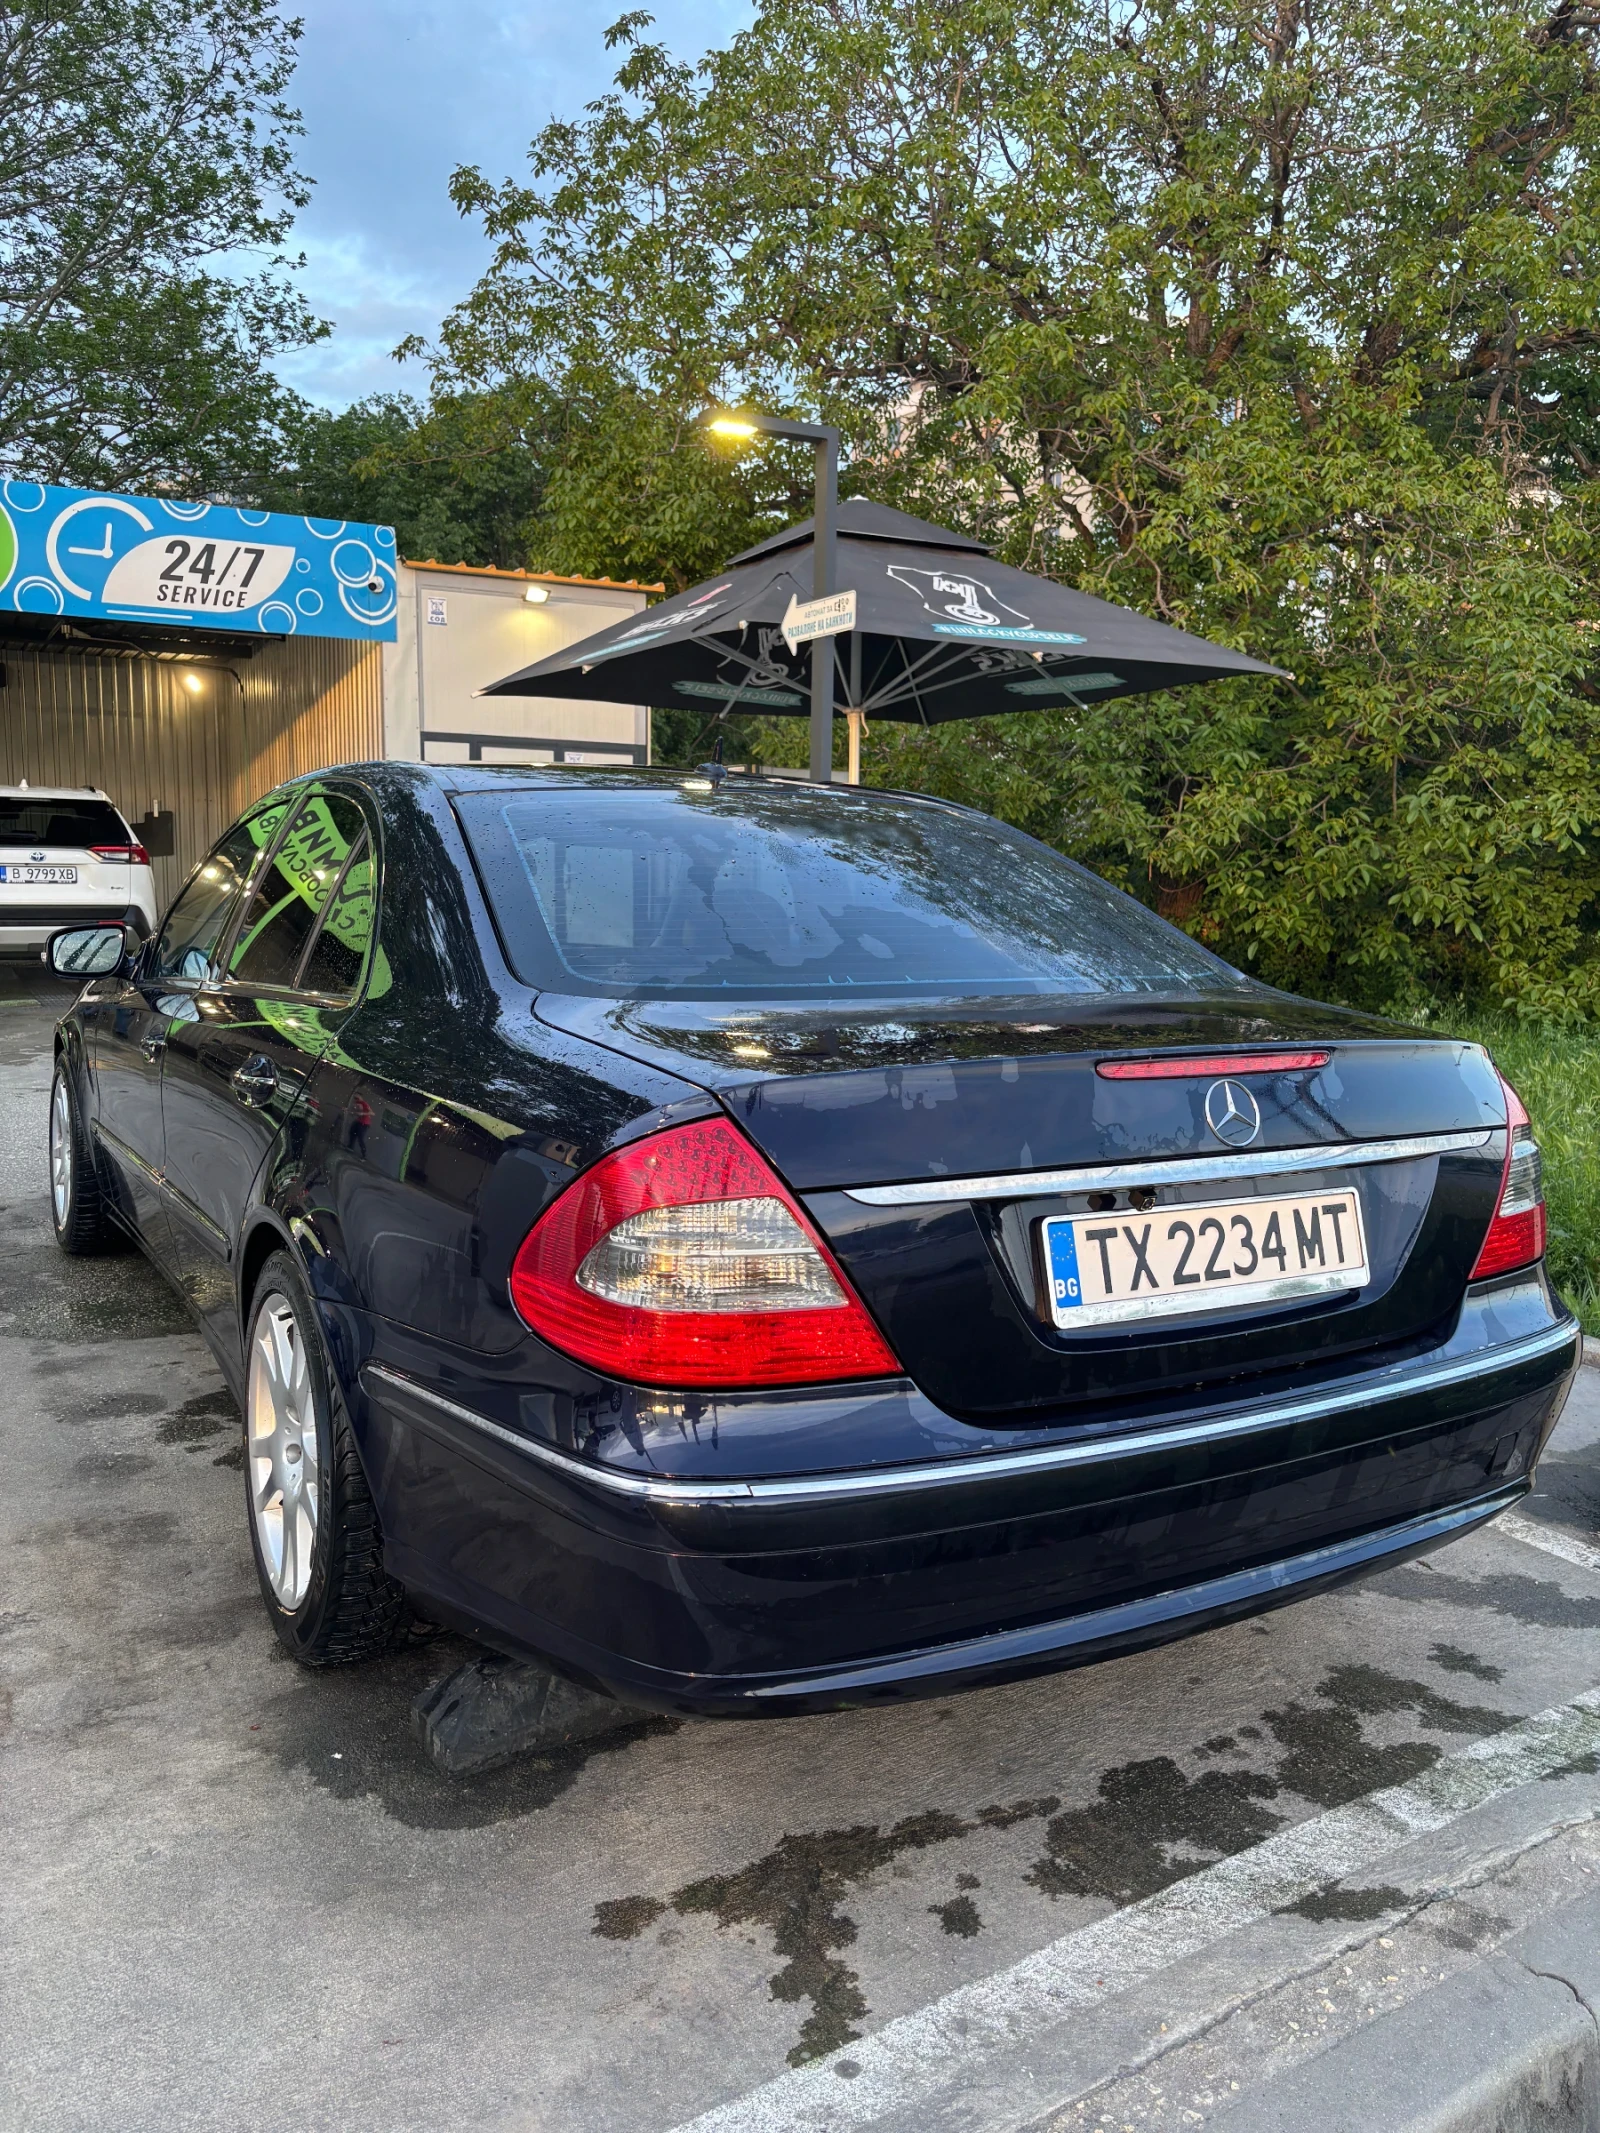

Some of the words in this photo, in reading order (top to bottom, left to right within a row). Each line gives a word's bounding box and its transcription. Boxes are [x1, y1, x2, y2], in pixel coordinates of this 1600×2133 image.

[160, 540, 265, 587] 24/7
[157, 584, 248, 608] SERVICE
[12, 868, 21, 879] B
[27, 868, 56, 880] 9799
[58, 869, 74, 880] XB
[1054, 1278, 1079, 1299] BG
[1085, 1223, 1160, 1294] TX
[1167, 1211, 1287, 1286] 2234
[1293, 1203, 1347, 1269] MT
